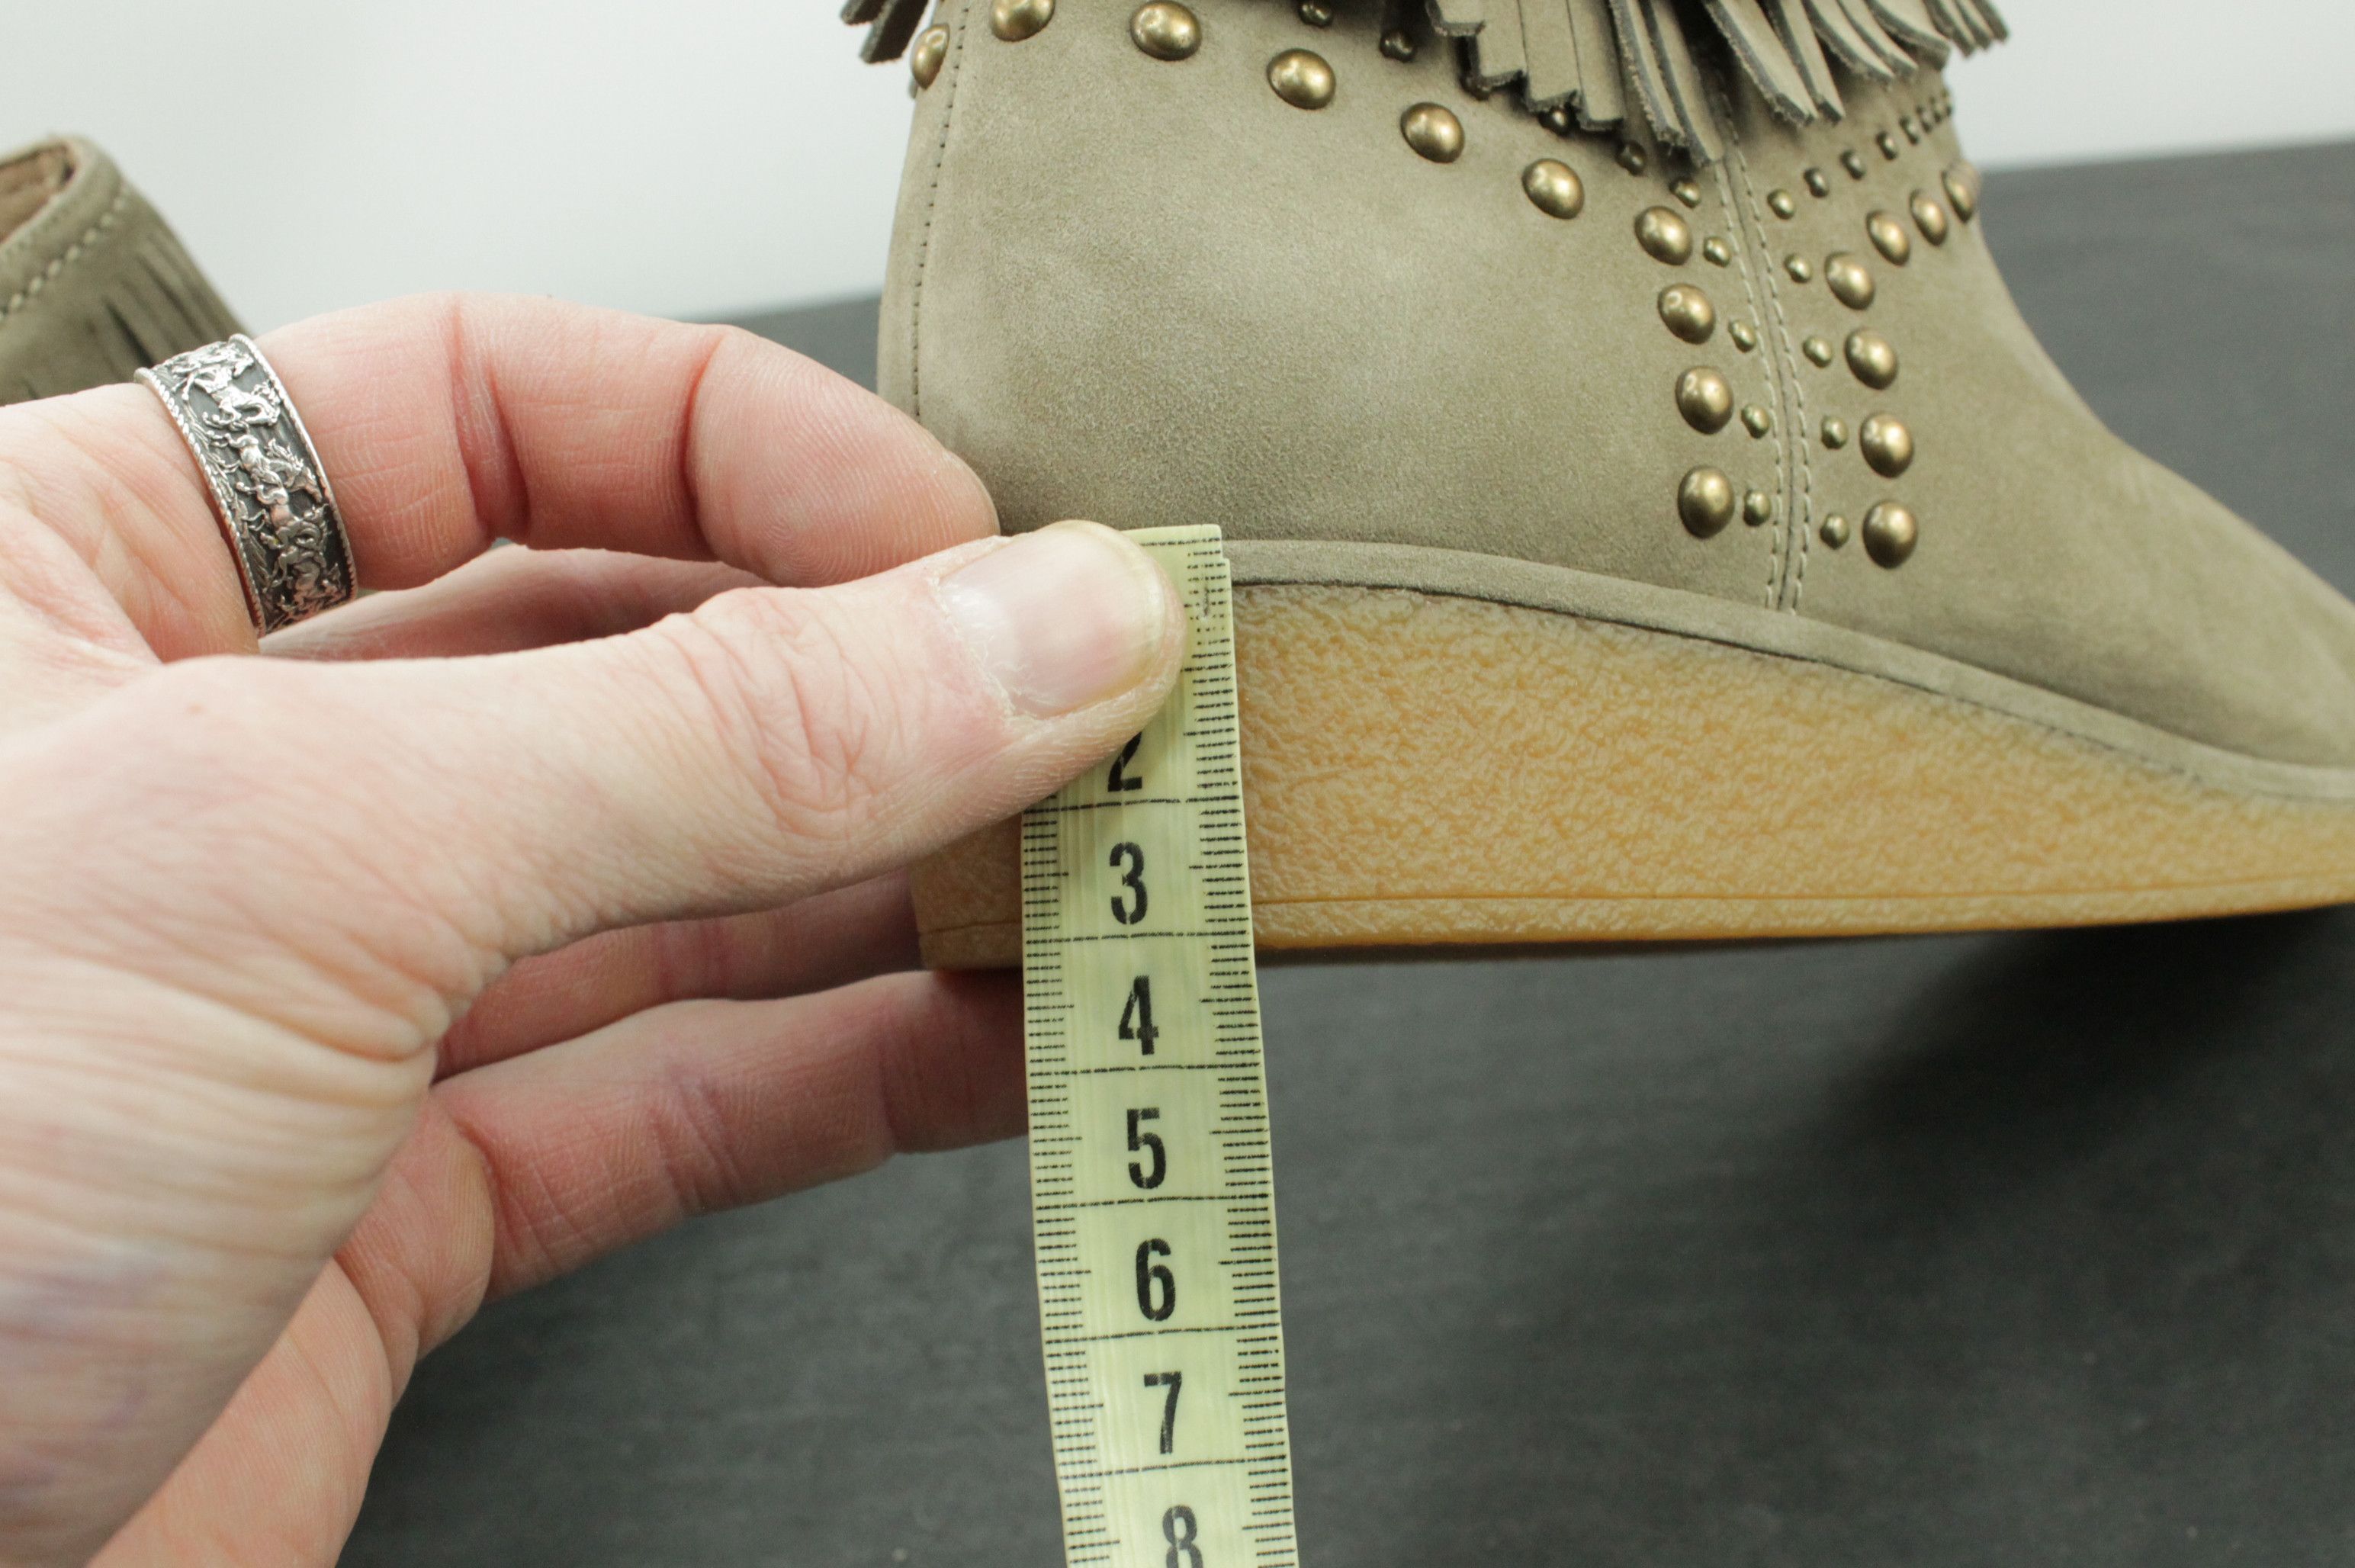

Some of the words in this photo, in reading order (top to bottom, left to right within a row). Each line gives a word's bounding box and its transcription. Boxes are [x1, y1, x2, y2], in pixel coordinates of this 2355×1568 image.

[1107, 731, 1142, 792] 2
[1110, 841, 1149, 925] 3
[1118, 975, 1160, 1056] 4
[1126, 1107, 1167, 1190] 5
[1136, 1238, 1176, 1322] 6
[1144, 1371, 1182, 1454] 7
[1162, 1505, 1203, 1568] 8
